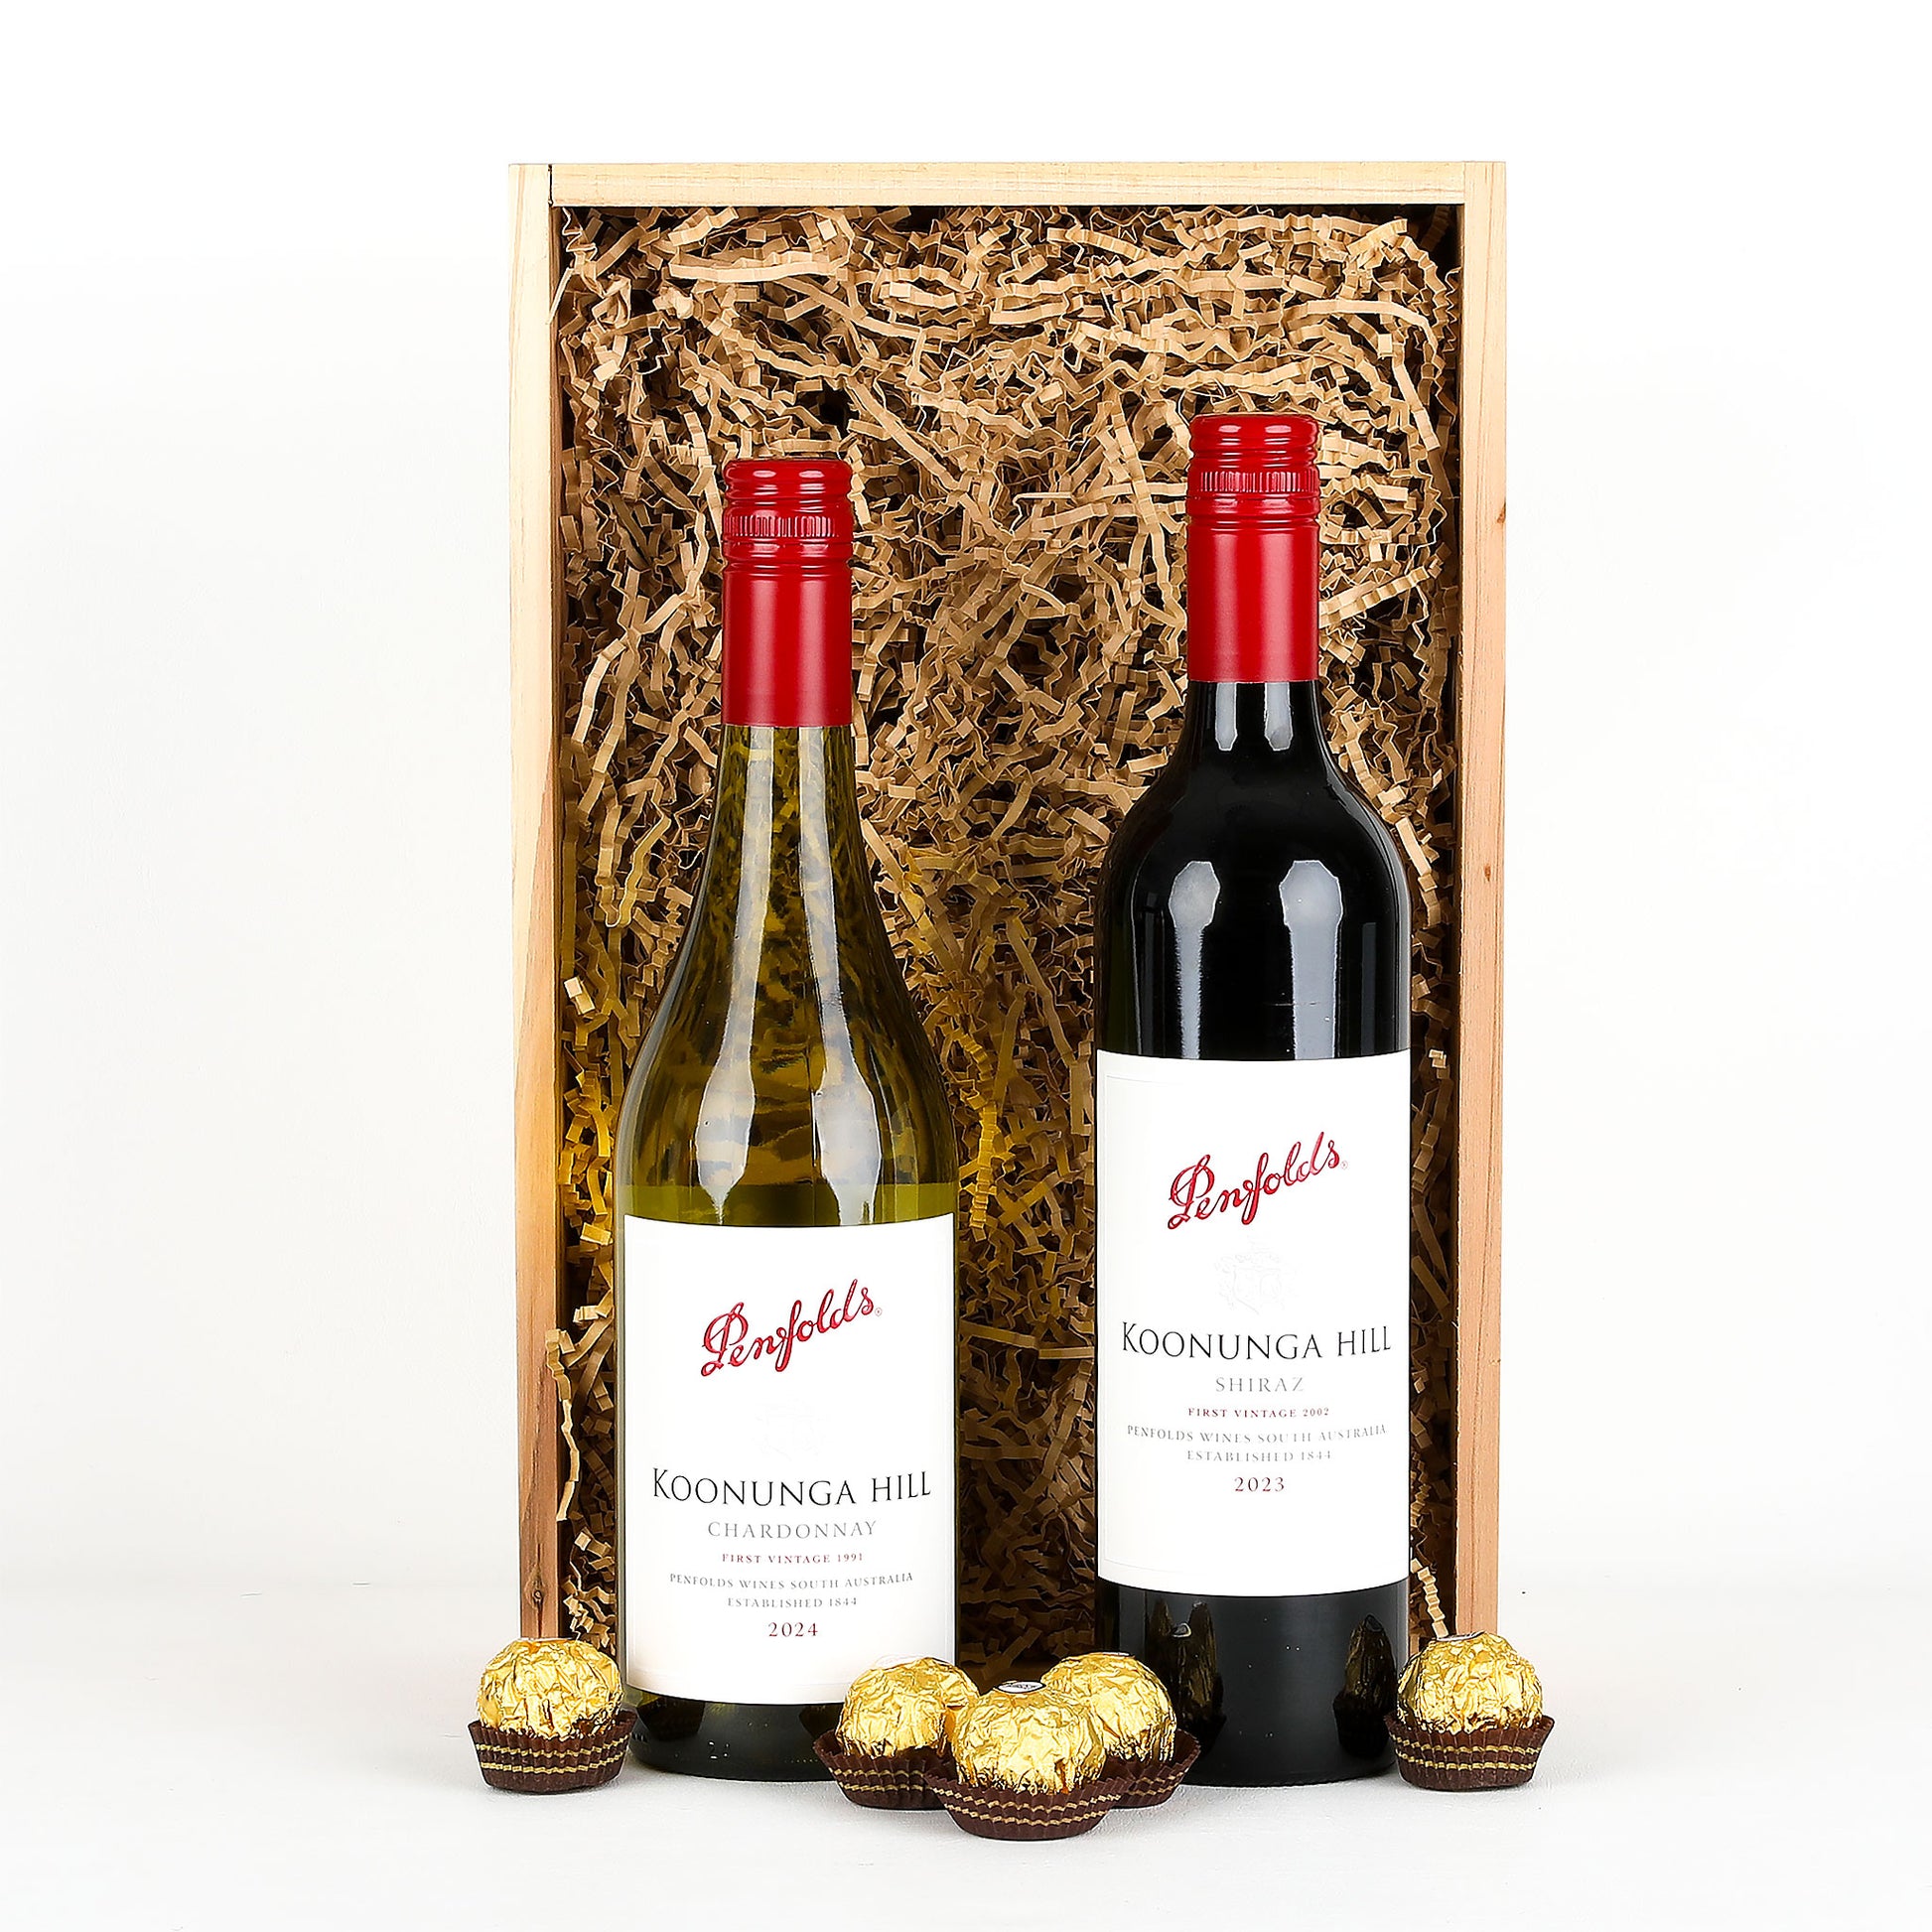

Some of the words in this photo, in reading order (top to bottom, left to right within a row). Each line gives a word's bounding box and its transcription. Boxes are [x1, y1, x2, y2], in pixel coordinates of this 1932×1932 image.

[1168, 1131, 1340, 1230] Penfolds
[700, 1278, 875, 1377] Penfolds
[1122, 1321, 1323, 1360] KOONUNGA
[1337, 1325, 1391, 1357] HILL
[1215, 1376, 1304, 1393] SHIRAZ
[1187, 1407, 1229, 1419] FIRST
[1233, 1408, 1297, 1419] VINTAGE
[1302, 1407, 1329, 1418] 2002
[1127, 1424, 1193, 1443] PENFOLDS
[1199, 1432, 1251, 1445] WINES
[1257, 1432, 1311, 1444] SOUTH
[1316, 1423, 1388, 1443] AUSTRALIA
[1186, 1449, 1294, 1462] ESTABLISHED
[1301, 1449, 1331, 1461] 1844
[652, 1467, 857, 1507] KOONUNGA
[871, 1471, 931, 1502] HILL
[1233, 1476, 1286, 1493] 2023
[707, 1520, 877, 1540] CHARDONNAY
[722, 1553, 762, 1565] FIRST
[767, 1554, 831, 1565] VINTAGE
[837, 1552, 863, 1563] 1991
[669, 1573, 734, 1588] PENFOLDS
[739, 1580, 785, 1589] WINES
[790, 1579, 839, 1590] SOUTH
[844, 1572, 913, 1587] AUSTRALIA
[727, 1596, 823, 1608] ESTABLISHED
[829, 1596, 857, 1607] 1844
[767, 1621, 819, 1638] 2024
